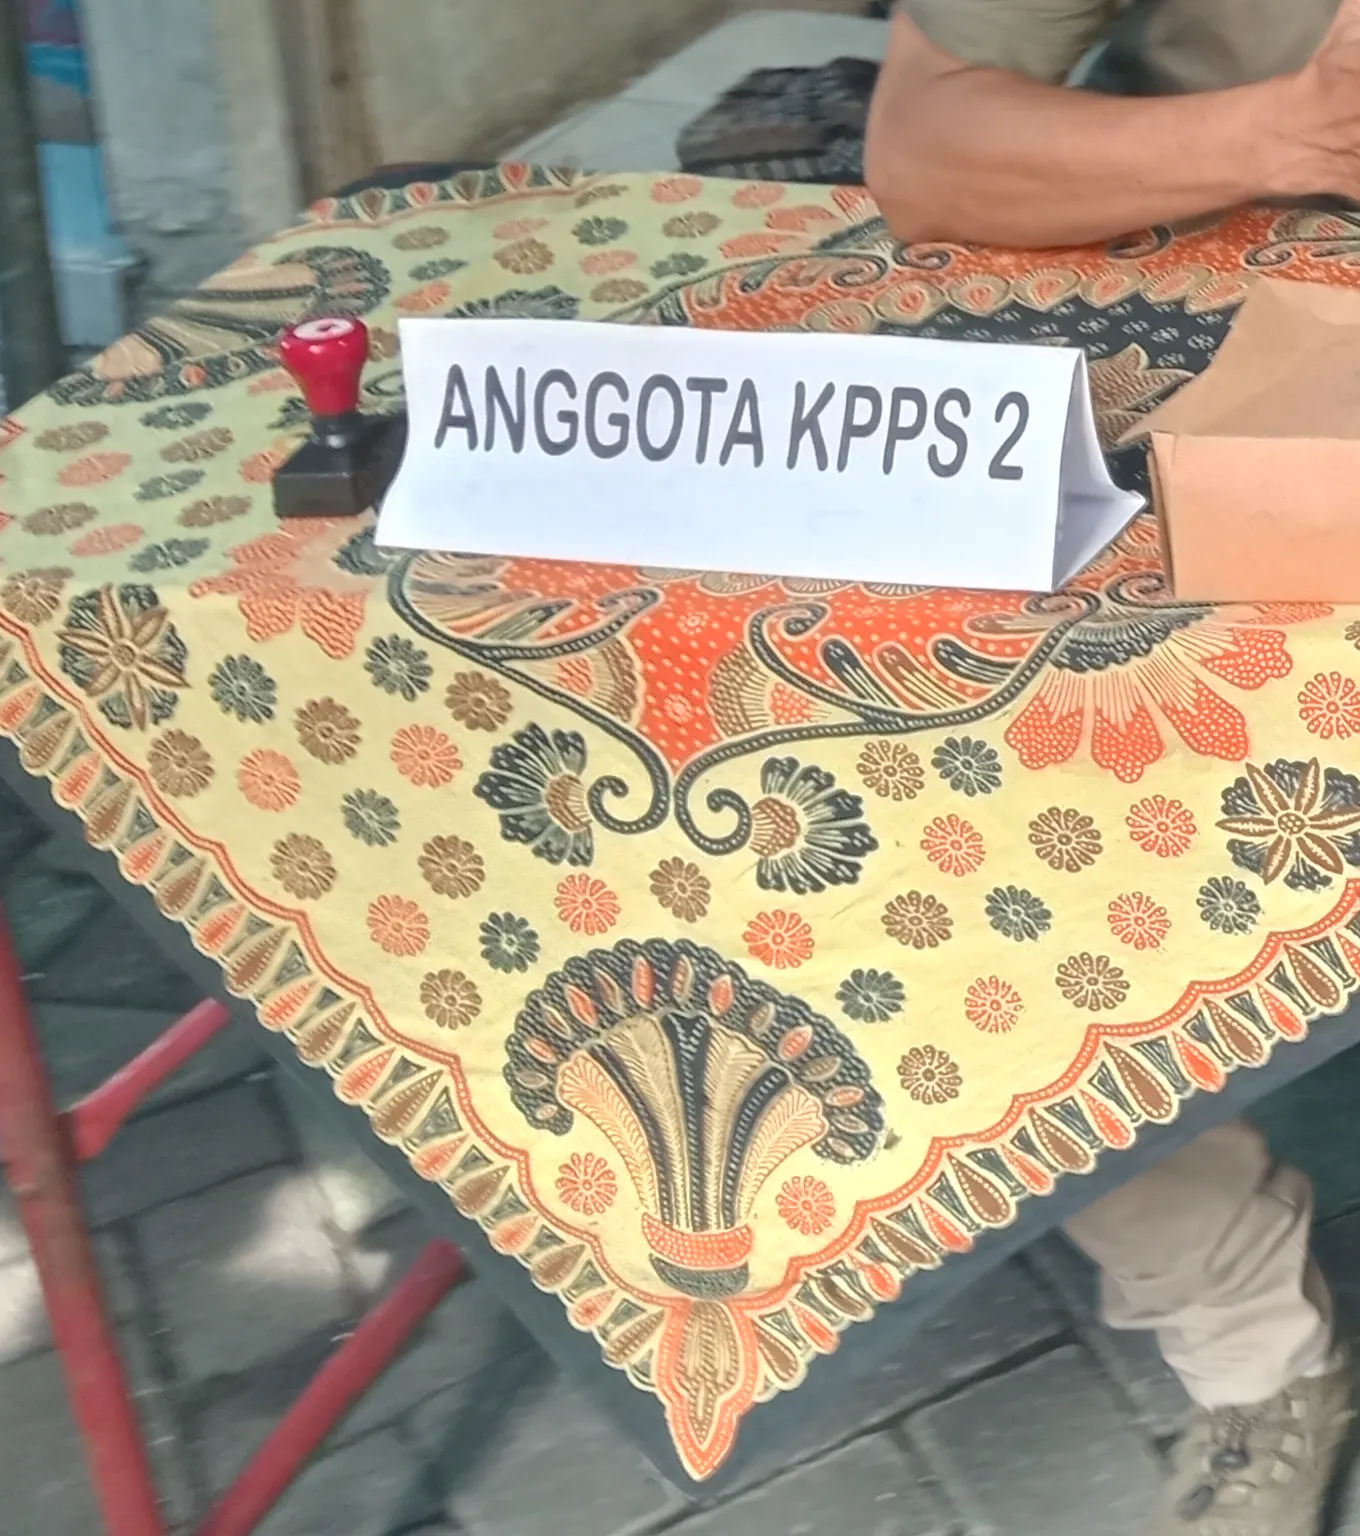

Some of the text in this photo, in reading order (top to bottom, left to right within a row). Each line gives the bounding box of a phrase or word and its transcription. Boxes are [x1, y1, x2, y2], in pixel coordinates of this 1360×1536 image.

[435, 365, 1029, 480] ANGGOTA KPPS 2
